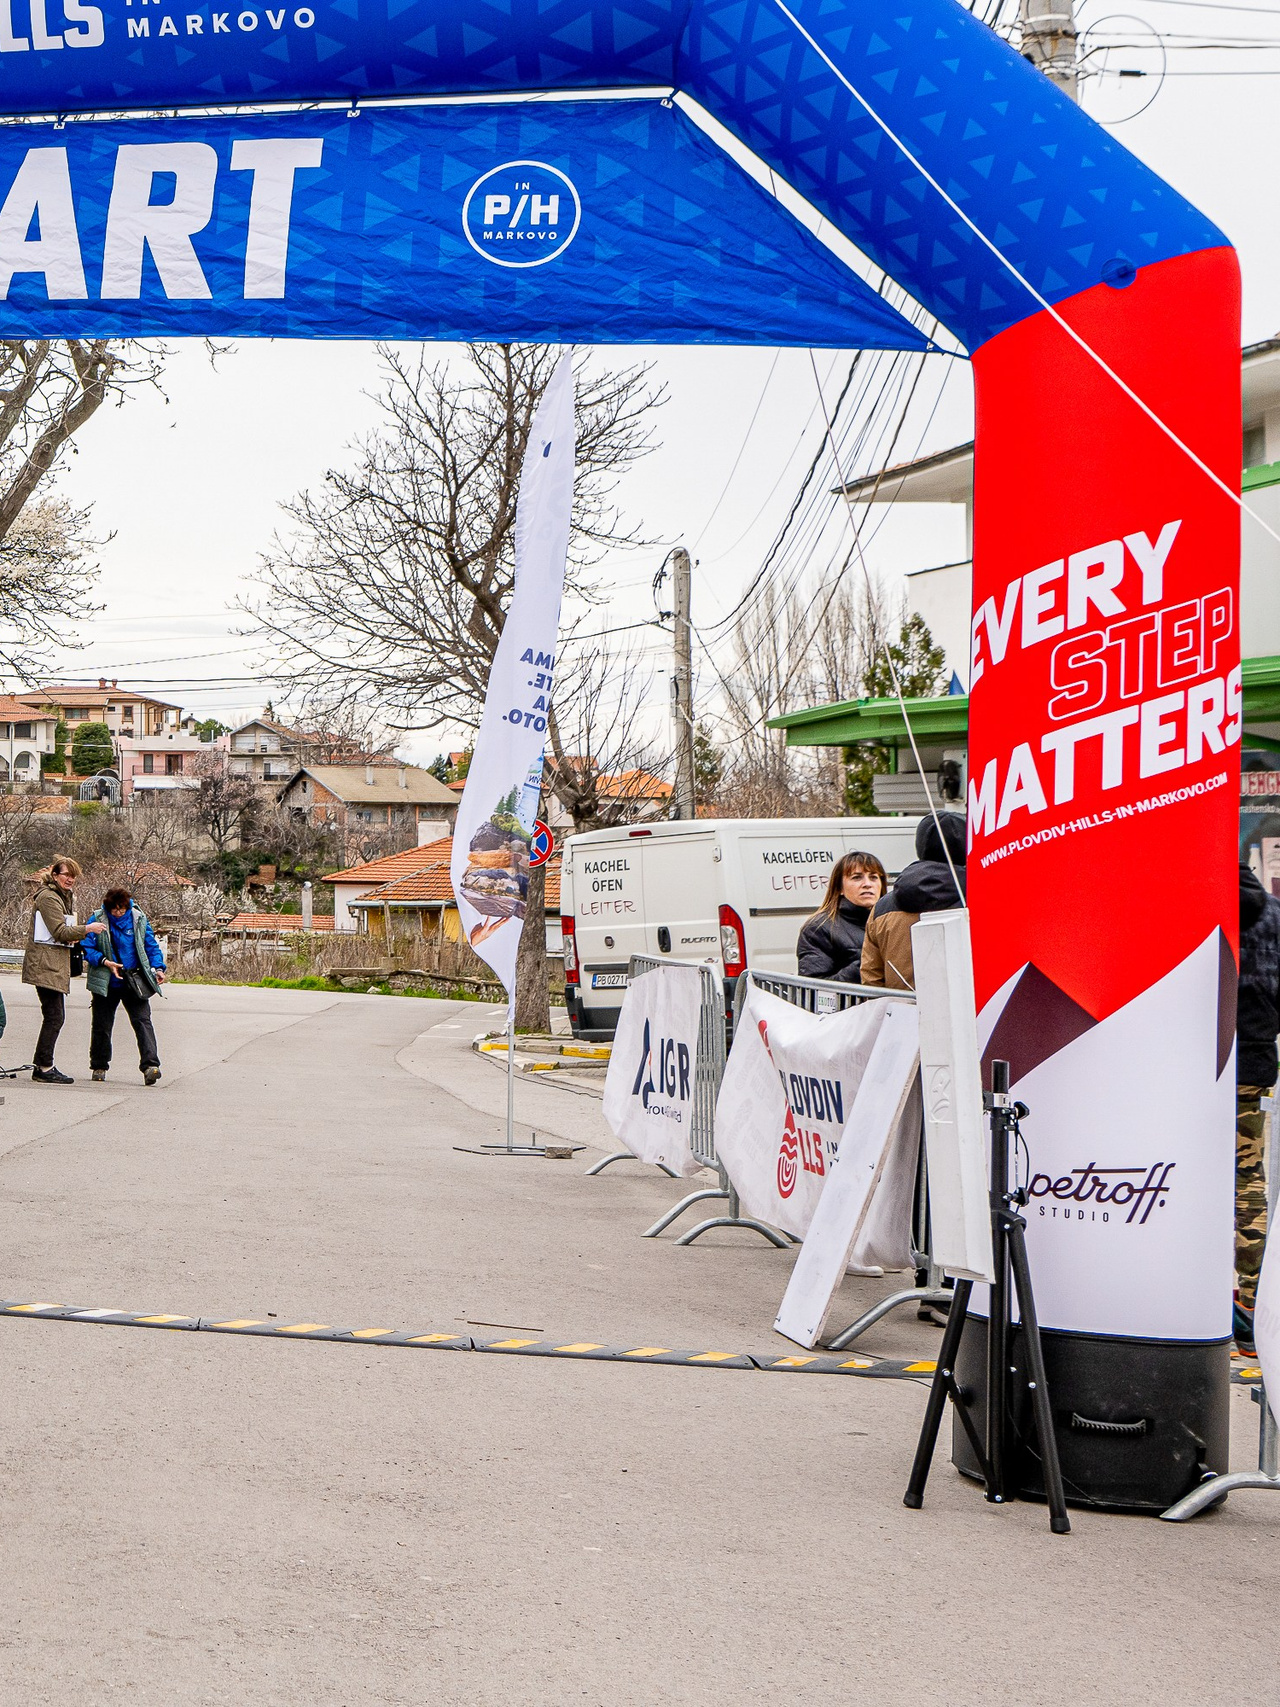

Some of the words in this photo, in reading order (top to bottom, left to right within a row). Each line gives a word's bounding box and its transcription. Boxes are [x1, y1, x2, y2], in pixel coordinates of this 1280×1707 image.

[127, 7, 316, 38] MARKOVO
[515, 182, 530, 190] IN
[484, 194, 560, 228] P/H
[483, 231, 558, 240] MARKOVO
[969, 519, 1183, 692] EVERY
[1048, 586, 1233, 721] STEP
[967, 662, 1243, 856] MATTERS
[980, 771, 1228, 868] WWW.PLOVDIV-HILLS-IN-MARKOVO.COM
[763, 850, 834, 864] KACHELÖFEN
[584, 859, 631, 875] KACHEL
[592, 877, 623, 892] ÖFEN
[772, 875, 829, 891] LEITER
[580, 900, 637, 917] LEITER
[681, 936, 718, 944] DUCATO
[797, 1127, 825, 1176] LLS
[1039, 1205, 1110, 1223] STUDIO
